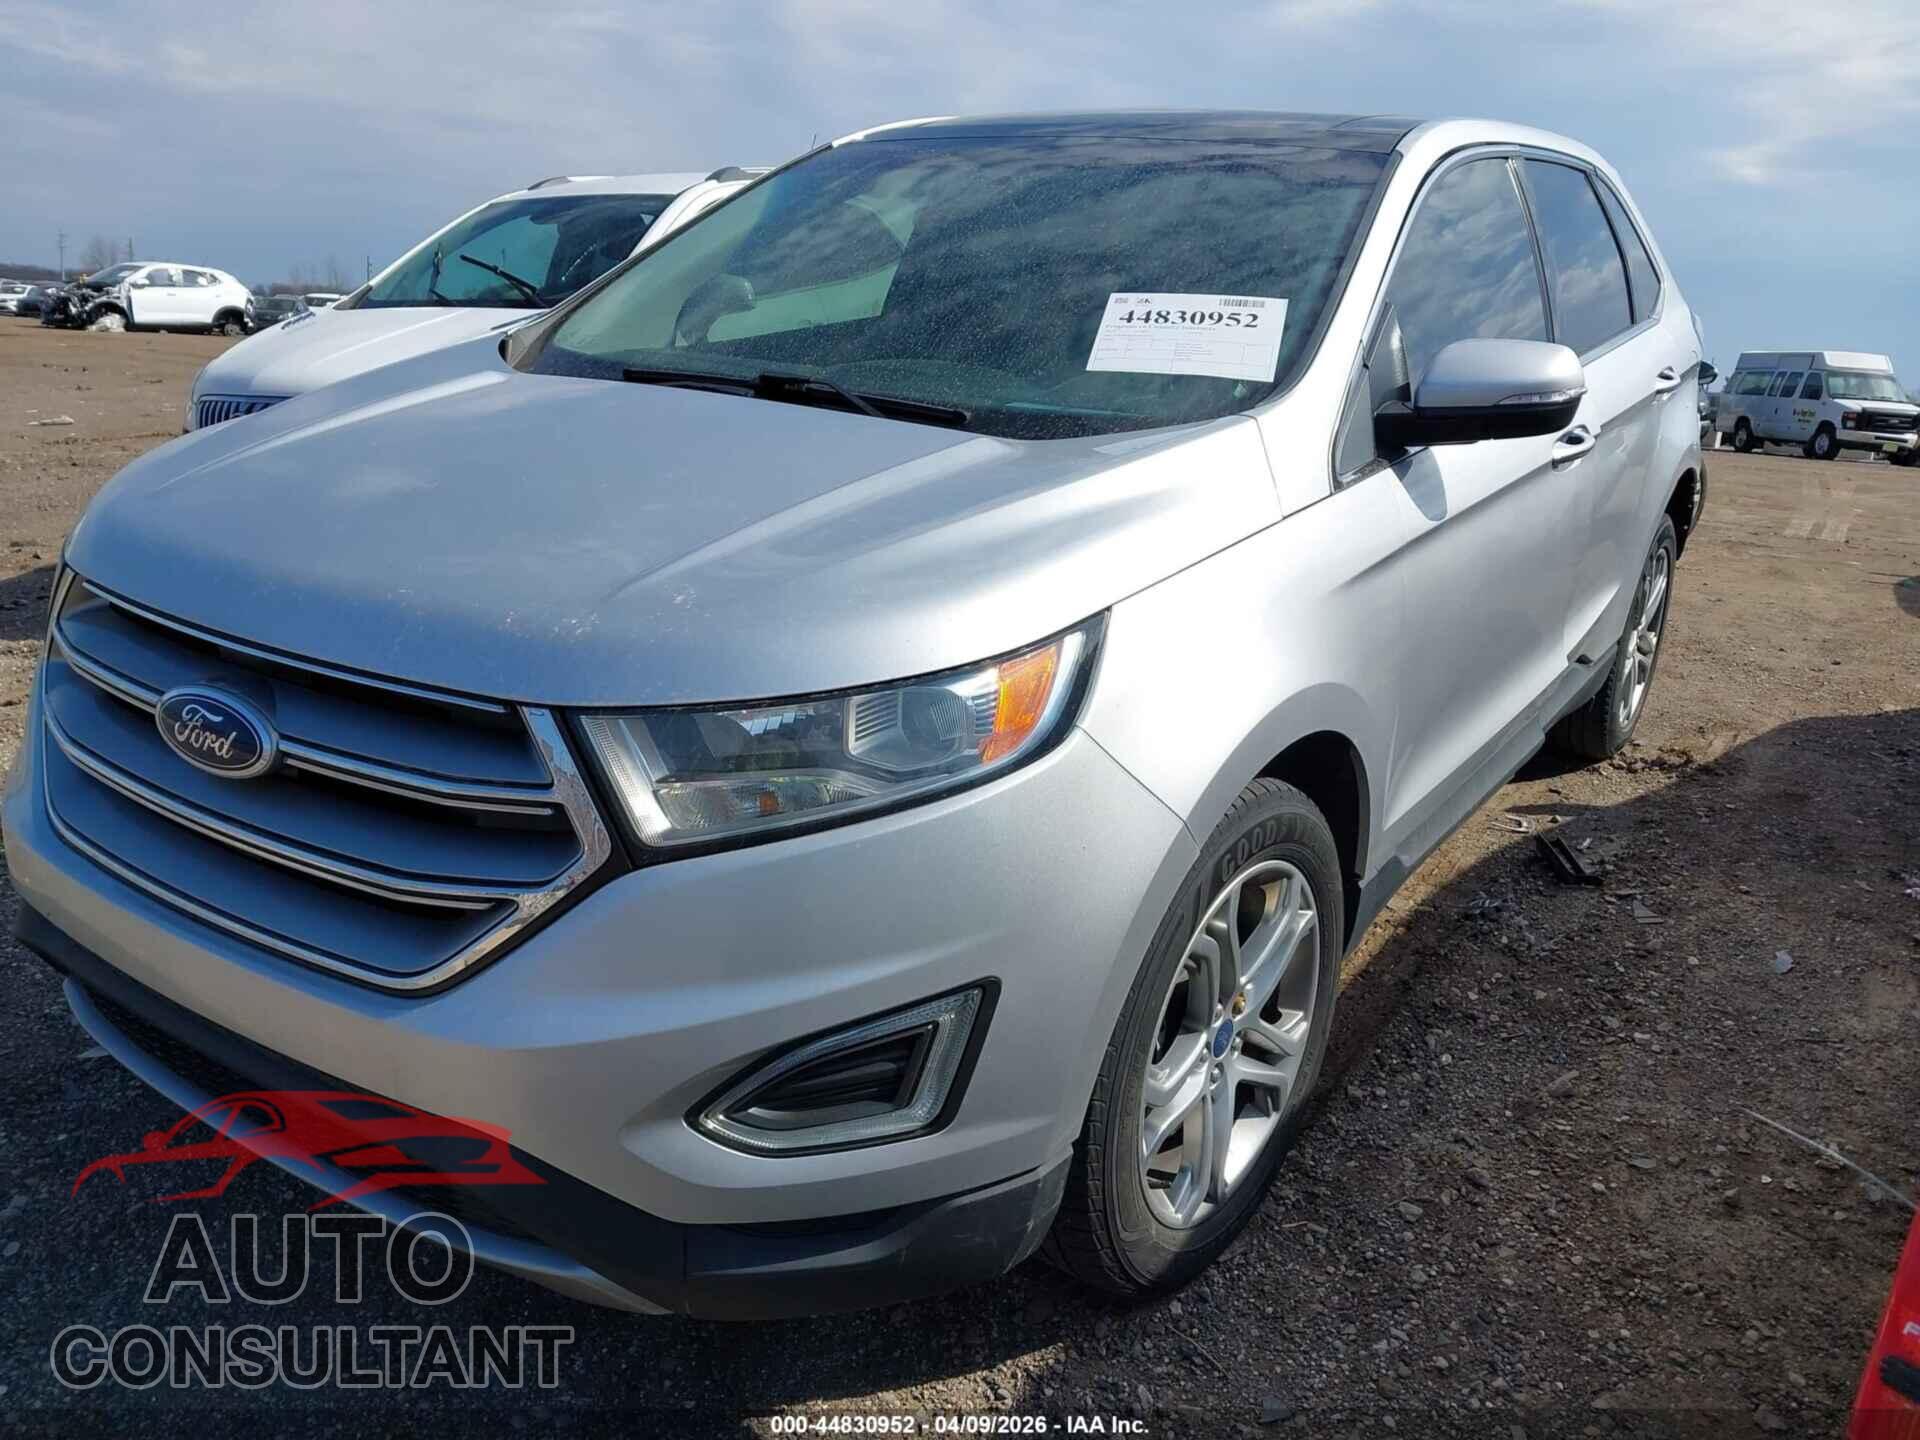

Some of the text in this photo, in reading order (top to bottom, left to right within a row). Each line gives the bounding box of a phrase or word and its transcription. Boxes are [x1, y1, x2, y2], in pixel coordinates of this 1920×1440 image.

[1119, 309, 1259, 328] 44830952
[174, 703, 238, 759] Ford
[1222, 817, 1312, 882] GOOD
